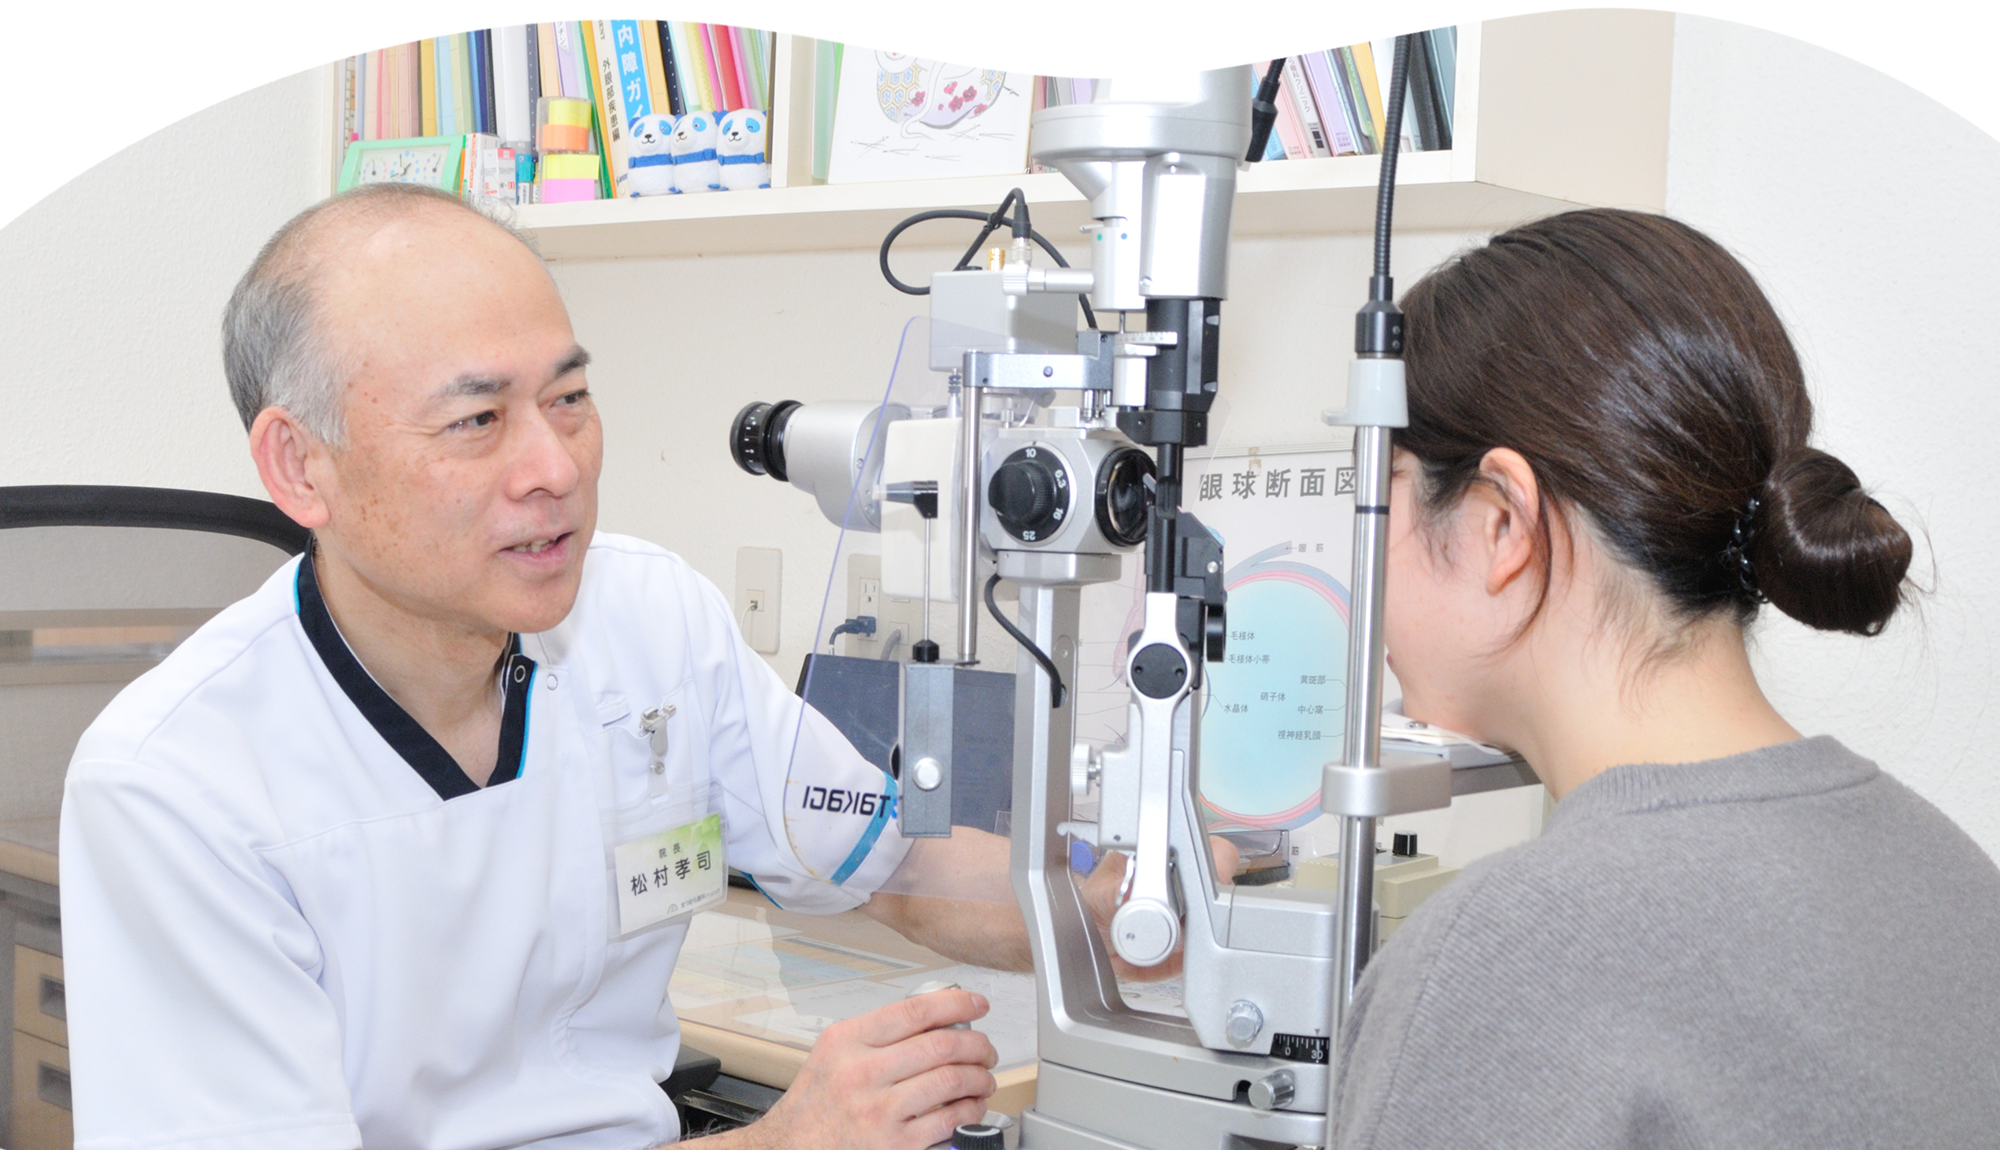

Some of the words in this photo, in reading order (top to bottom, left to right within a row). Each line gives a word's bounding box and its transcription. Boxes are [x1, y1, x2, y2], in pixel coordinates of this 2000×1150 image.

[616, 19, 644, 118] 内障ガイ
[1025, 448, 1037, 458] 10
[1054, 469, 1067, 489] 6.3
[1199, 467, 1356, 502] 眼球断面図
[1052, 508, 1063, 521] 16
[1022, 530, 1036, 541] 25
[1300, 675, 1326, 685] 黄斑部
[1260, 692, 1286, 702] 硝子体
[1223, 703, 1249, 713] 水晶体
[1278, 730, 1321, 741] 視神経乳頭
[658, 842, 681, 859] 院長
[630, 850, 711, 897] 松村孝司
[1311, 1049, 1323, 1060] 30
